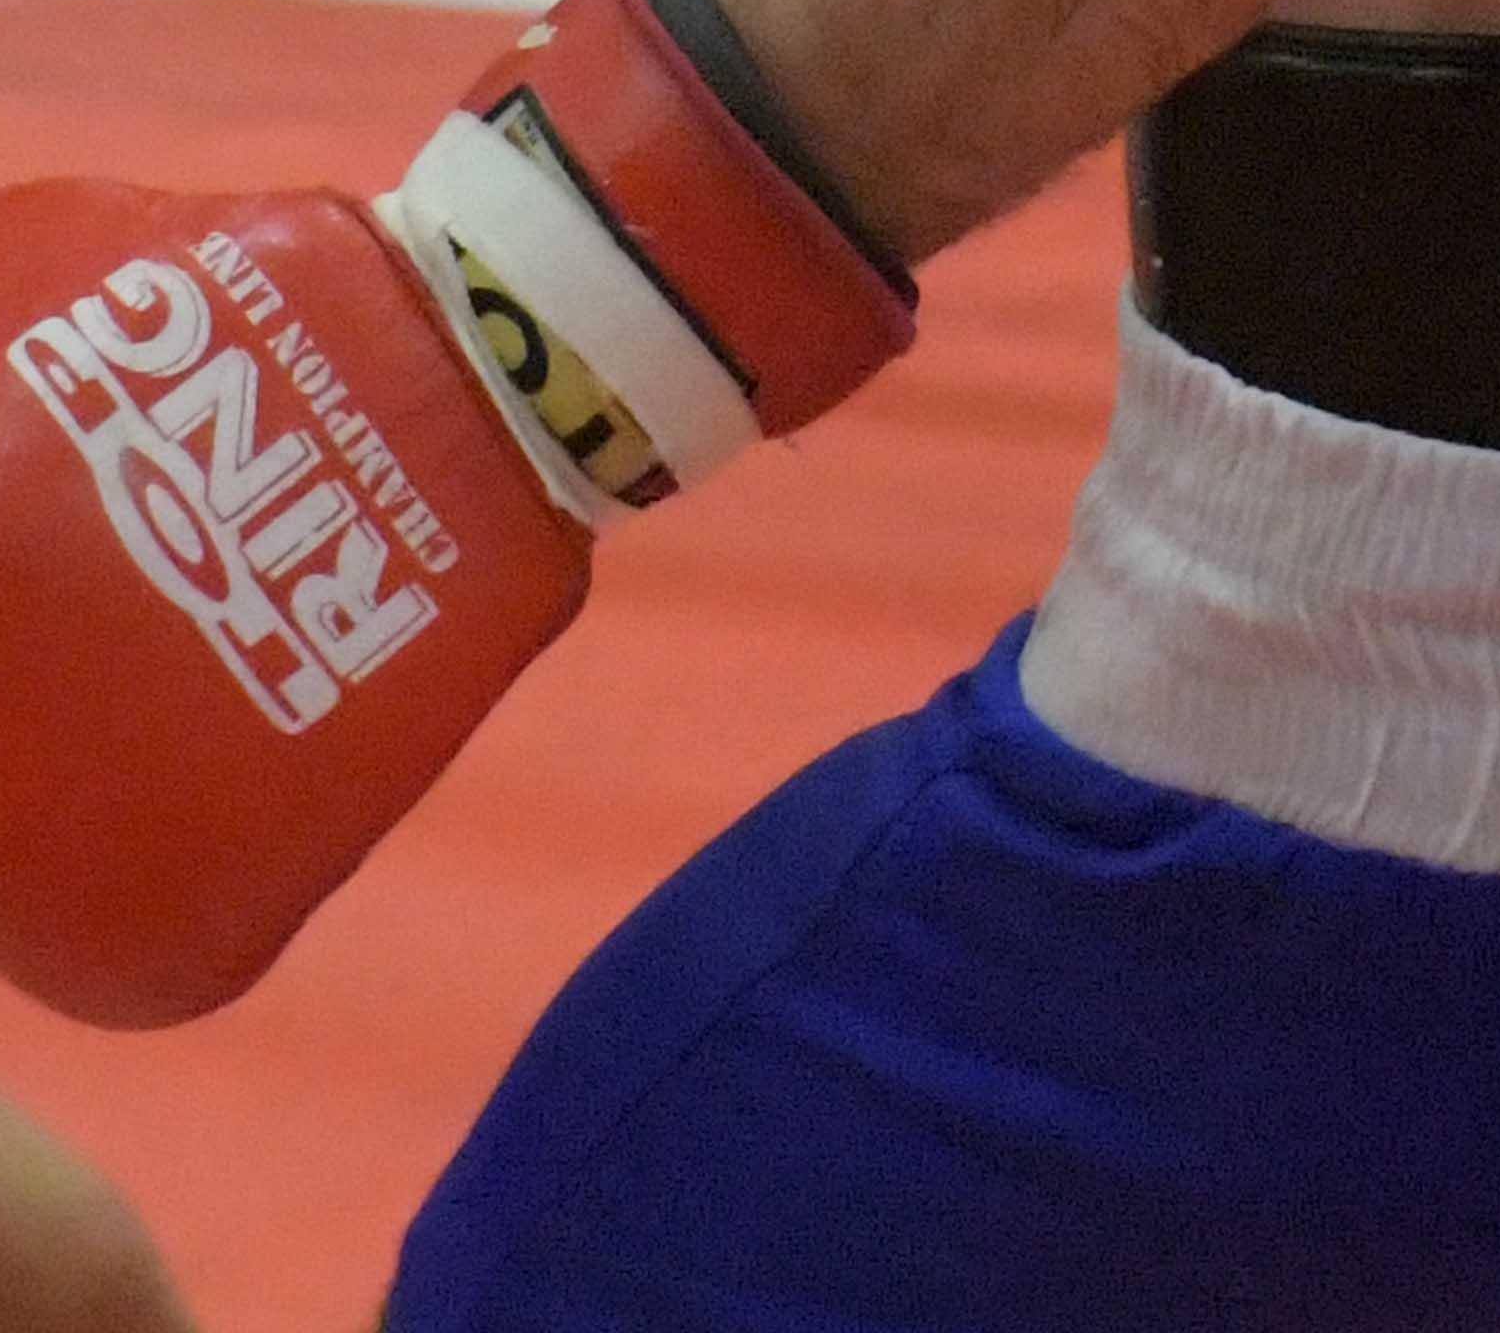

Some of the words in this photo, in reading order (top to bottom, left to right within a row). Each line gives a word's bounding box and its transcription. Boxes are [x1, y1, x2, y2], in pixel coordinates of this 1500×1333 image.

[188, 230, 286, 326] LINE
[7, 315, 342, 735] TOP
[70, 258, 440, 685] RING
[265, 321, 460, 575] CHAMPION
